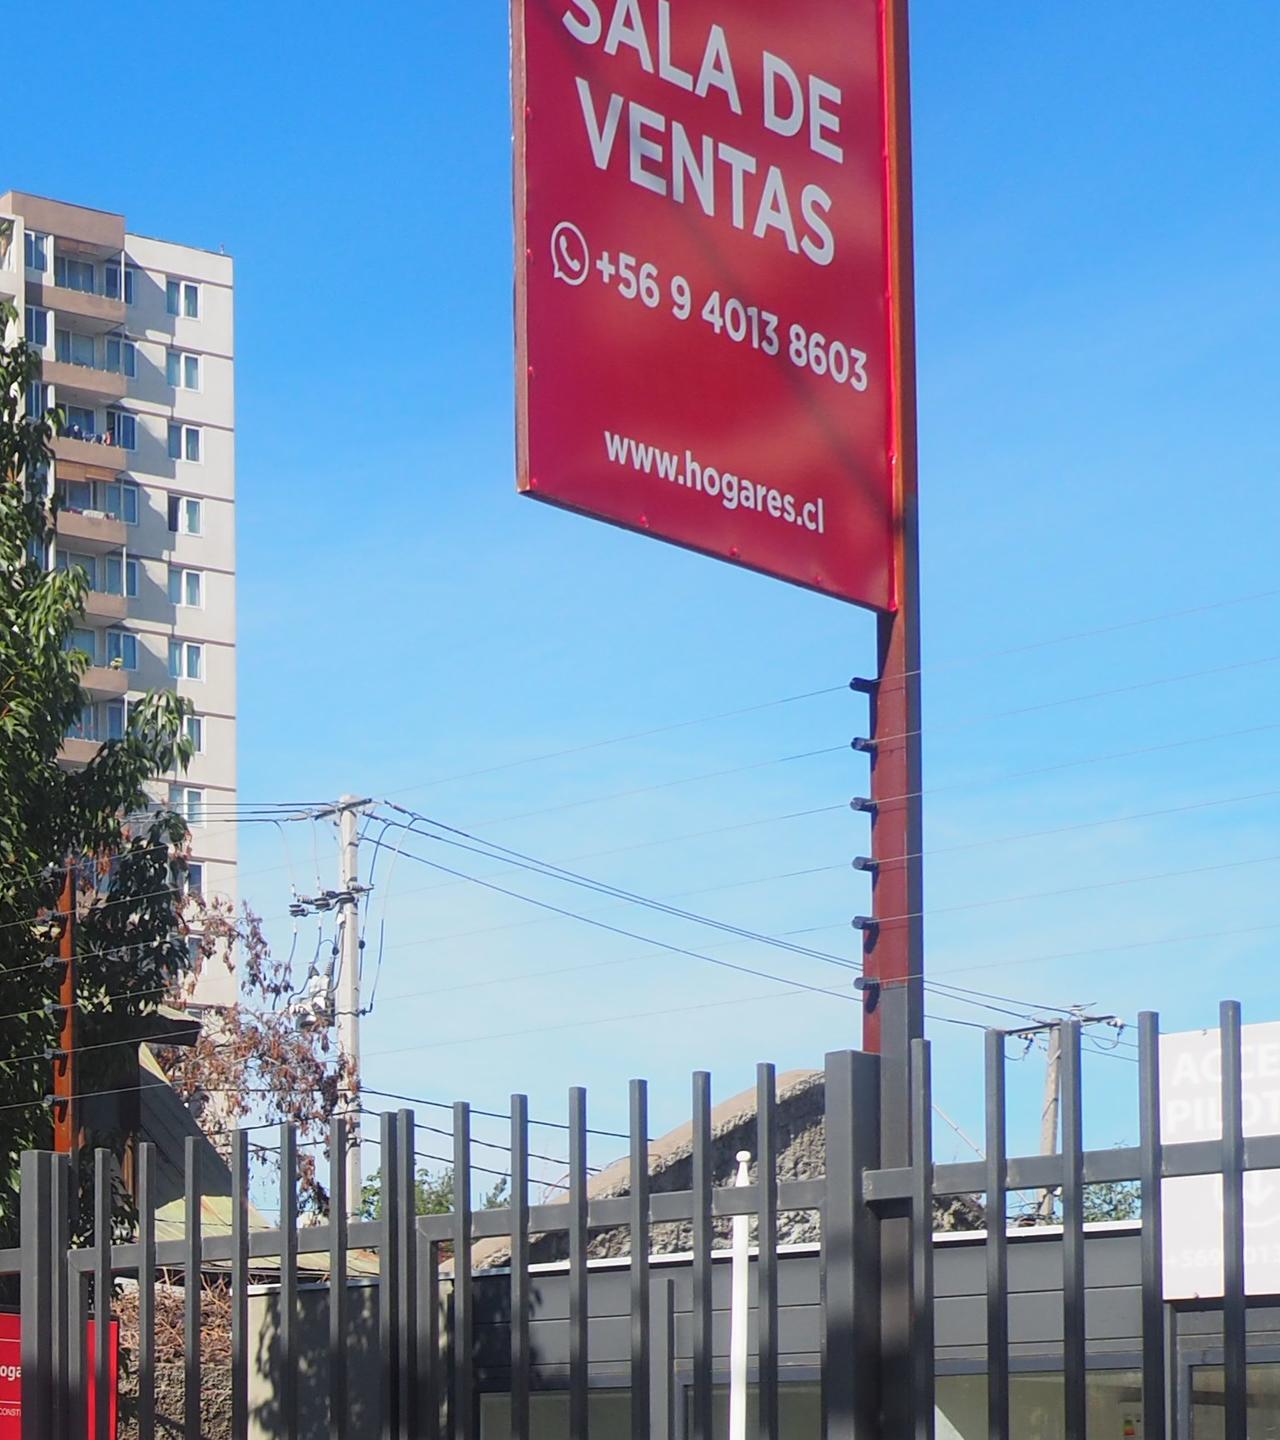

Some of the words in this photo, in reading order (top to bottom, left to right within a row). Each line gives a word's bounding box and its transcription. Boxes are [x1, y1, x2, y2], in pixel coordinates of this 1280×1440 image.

[561, 0, 742, 115] SALA
[763, 51, 843, 165] DE
[575, 76, 836, 266] VENTAS
[596, 251, 660, 308] +56
[671, 277, 691, 320] 9
[702, 291, 778, 355] 4013
[789, 324, 868, 391] 8603
[604, 431, 824, 534] www.hogares.cl
